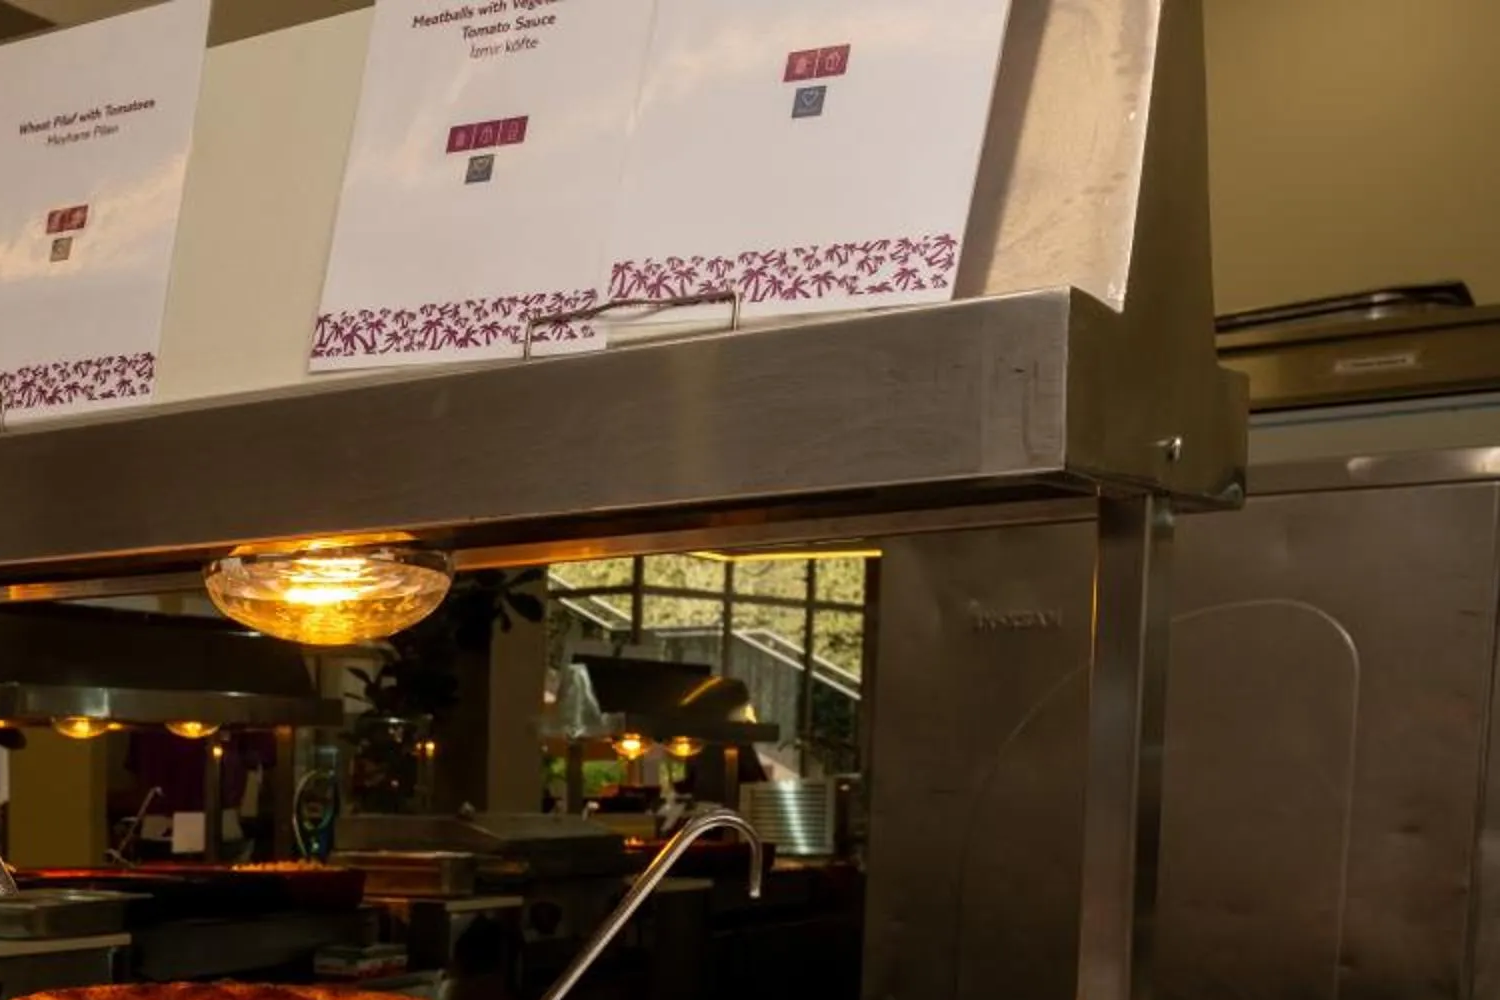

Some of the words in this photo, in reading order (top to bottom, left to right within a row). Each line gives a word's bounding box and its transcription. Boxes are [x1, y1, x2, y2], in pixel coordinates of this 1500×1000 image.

[412, 6, 475, 28] Meatballs
[478, 1, 506, 16] with
[463, 22, 510, 40] Tomato
[515, 14, 556, 31] Sauce
